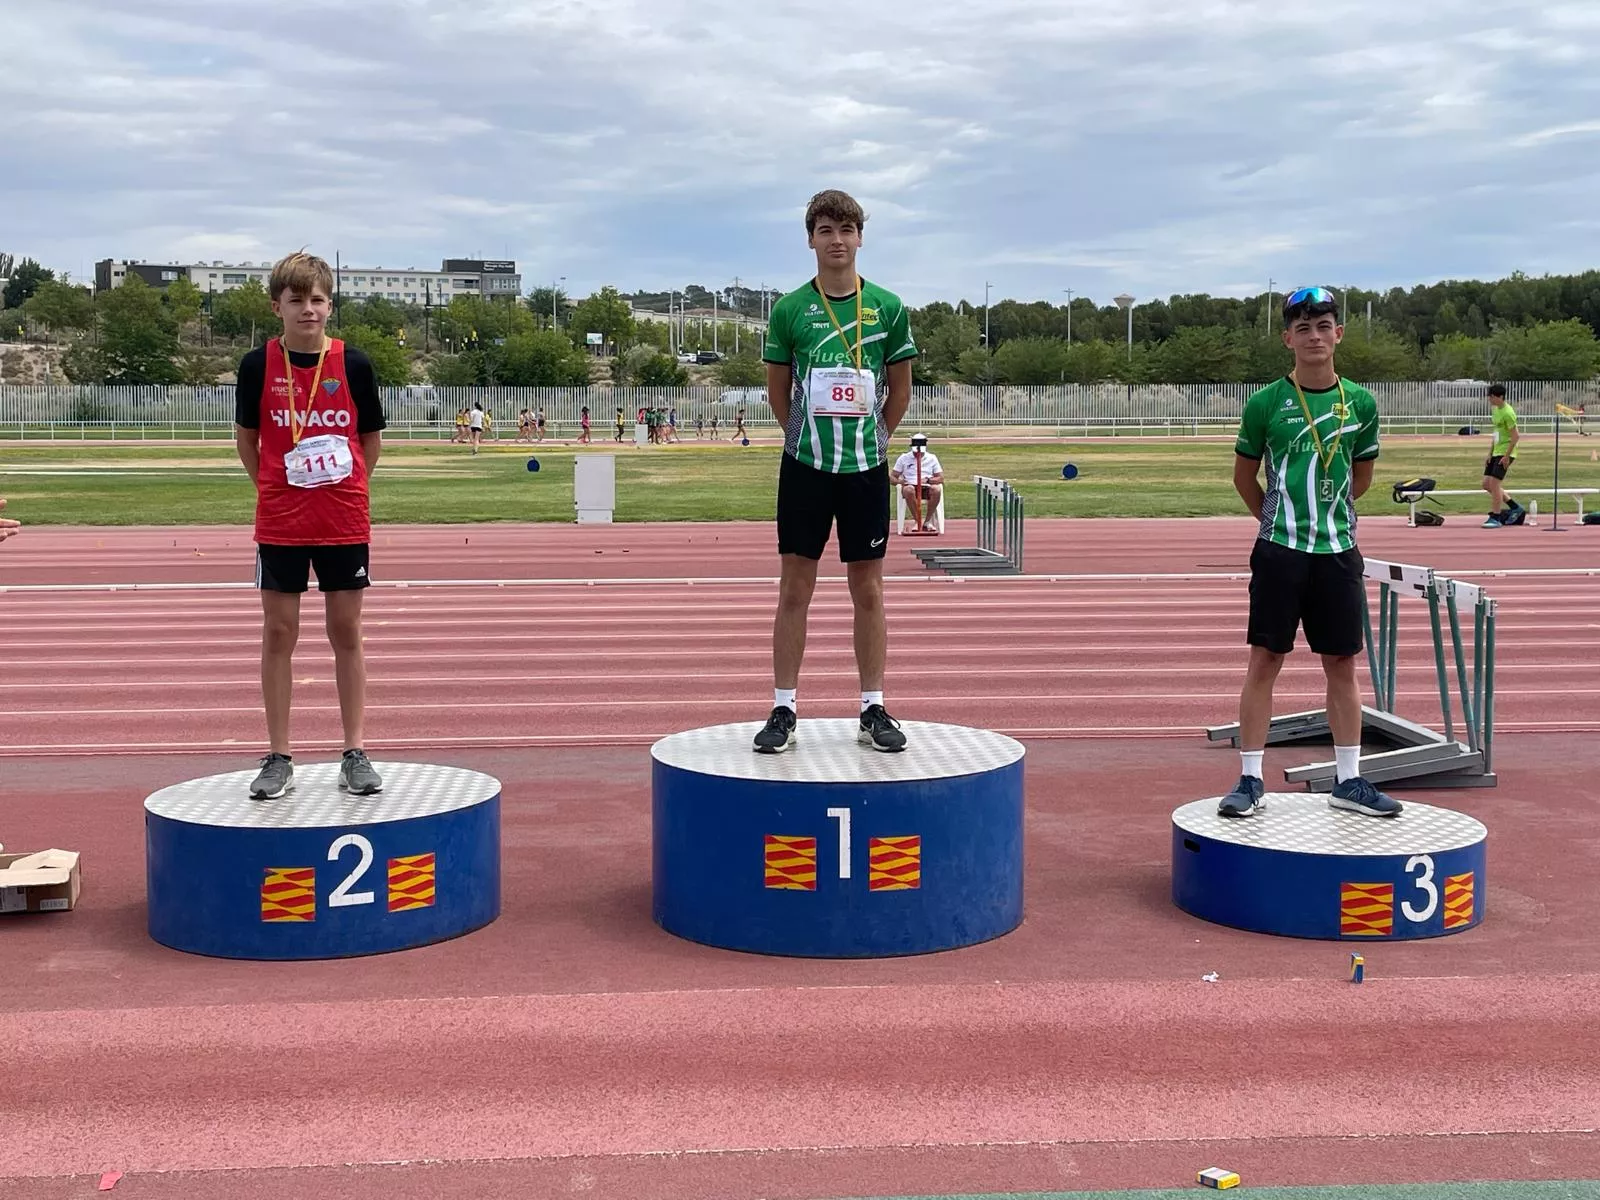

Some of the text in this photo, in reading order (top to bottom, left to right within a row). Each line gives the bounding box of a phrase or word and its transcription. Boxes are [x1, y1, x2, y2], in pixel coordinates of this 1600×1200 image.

[832, 387, 854, 402] 89
[303, 454, 338, 473] 111
[328, 834, 376, 907] 2
[827, 808, 851, 879] 1
[1401, 854, 1438, 922] 3
